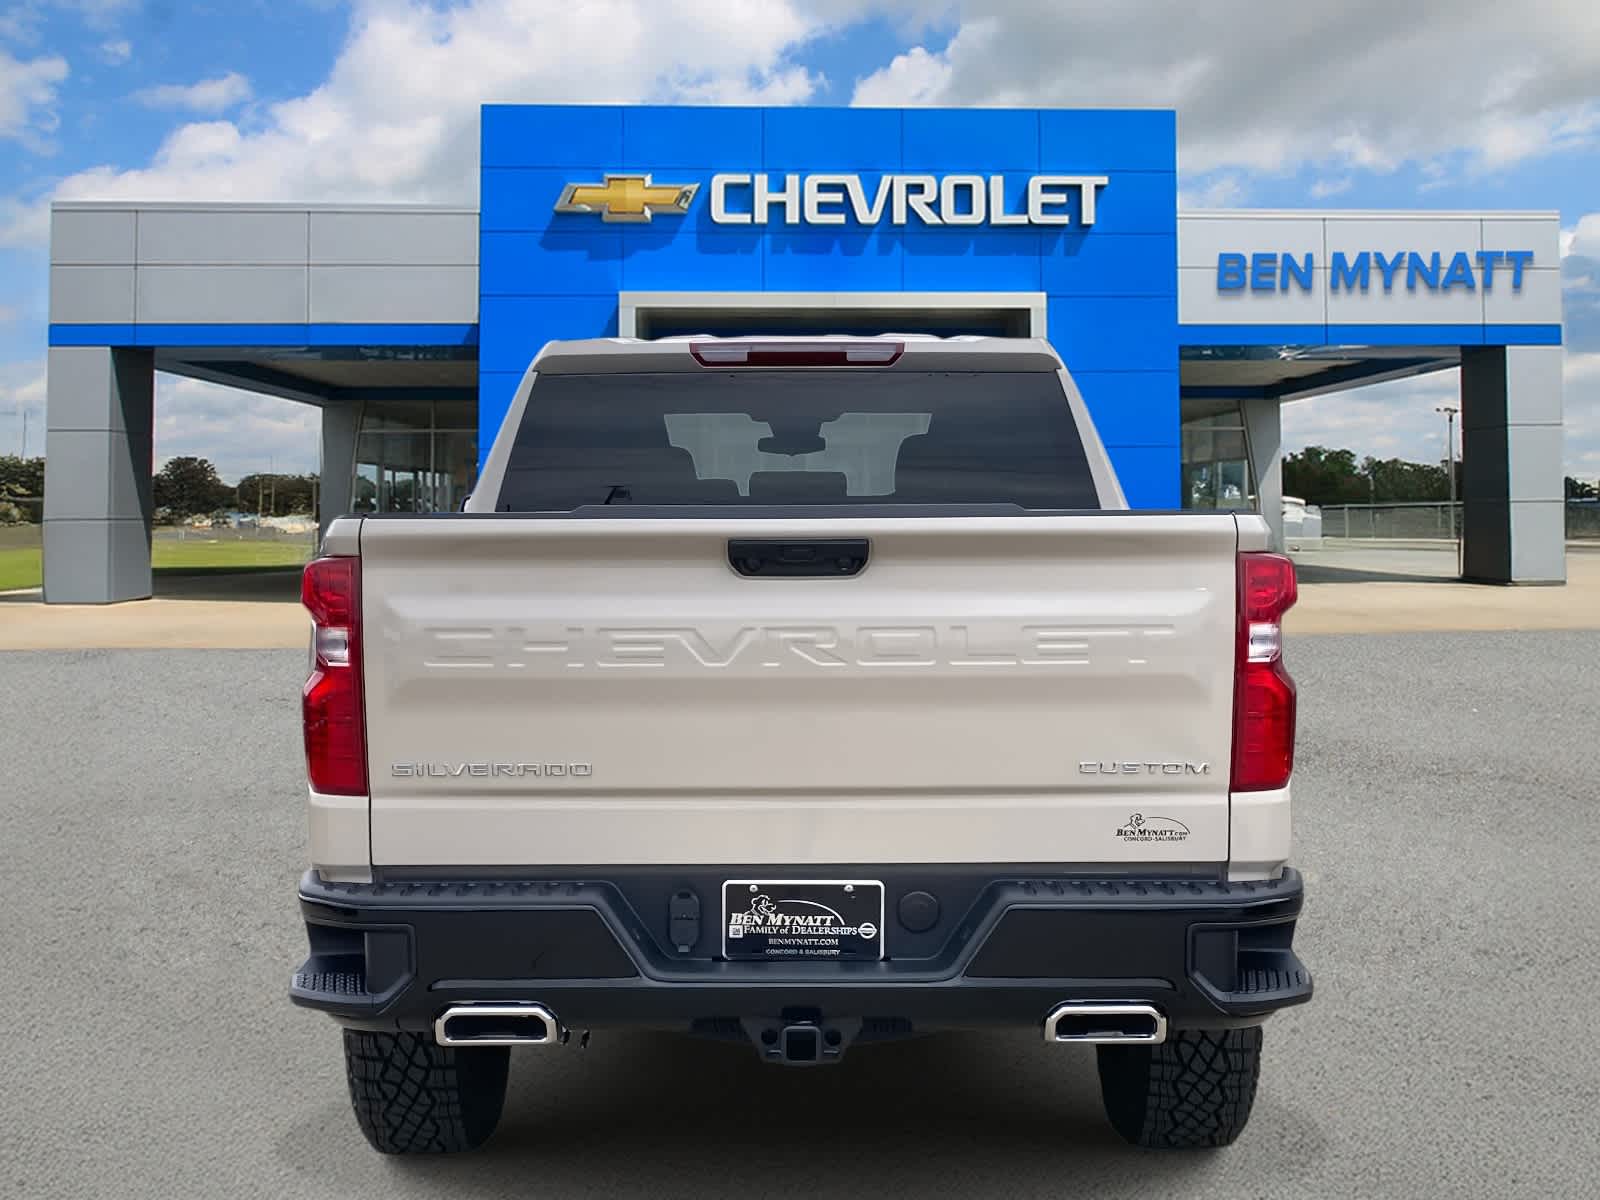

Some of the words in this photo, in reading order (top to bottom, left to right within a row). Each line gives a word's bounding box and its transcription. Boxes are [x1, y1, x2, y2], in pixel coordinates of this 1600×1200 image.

[710, 173, 1109, 225] CHEVROLET
[1216, 252, 1314, 291] BEN
[1330, 250, 1534, 291] MYNATT
[423, 625, 1175, 667] CHEVROLET
[391, 761, 593, 777] SILVERADO
[1079, 760, 1211, 775] CUSTOM
[728, 913, 765, 926] BEN
[766, 913, 835, 926] MYNATT
[743, 926, 780, 935] FAMILY
[779, 926, 789, 935] of
[791, 925, 858, 936] DEALERSHIPS
[768, 938, 840, 946] BENMYNATT.COM
